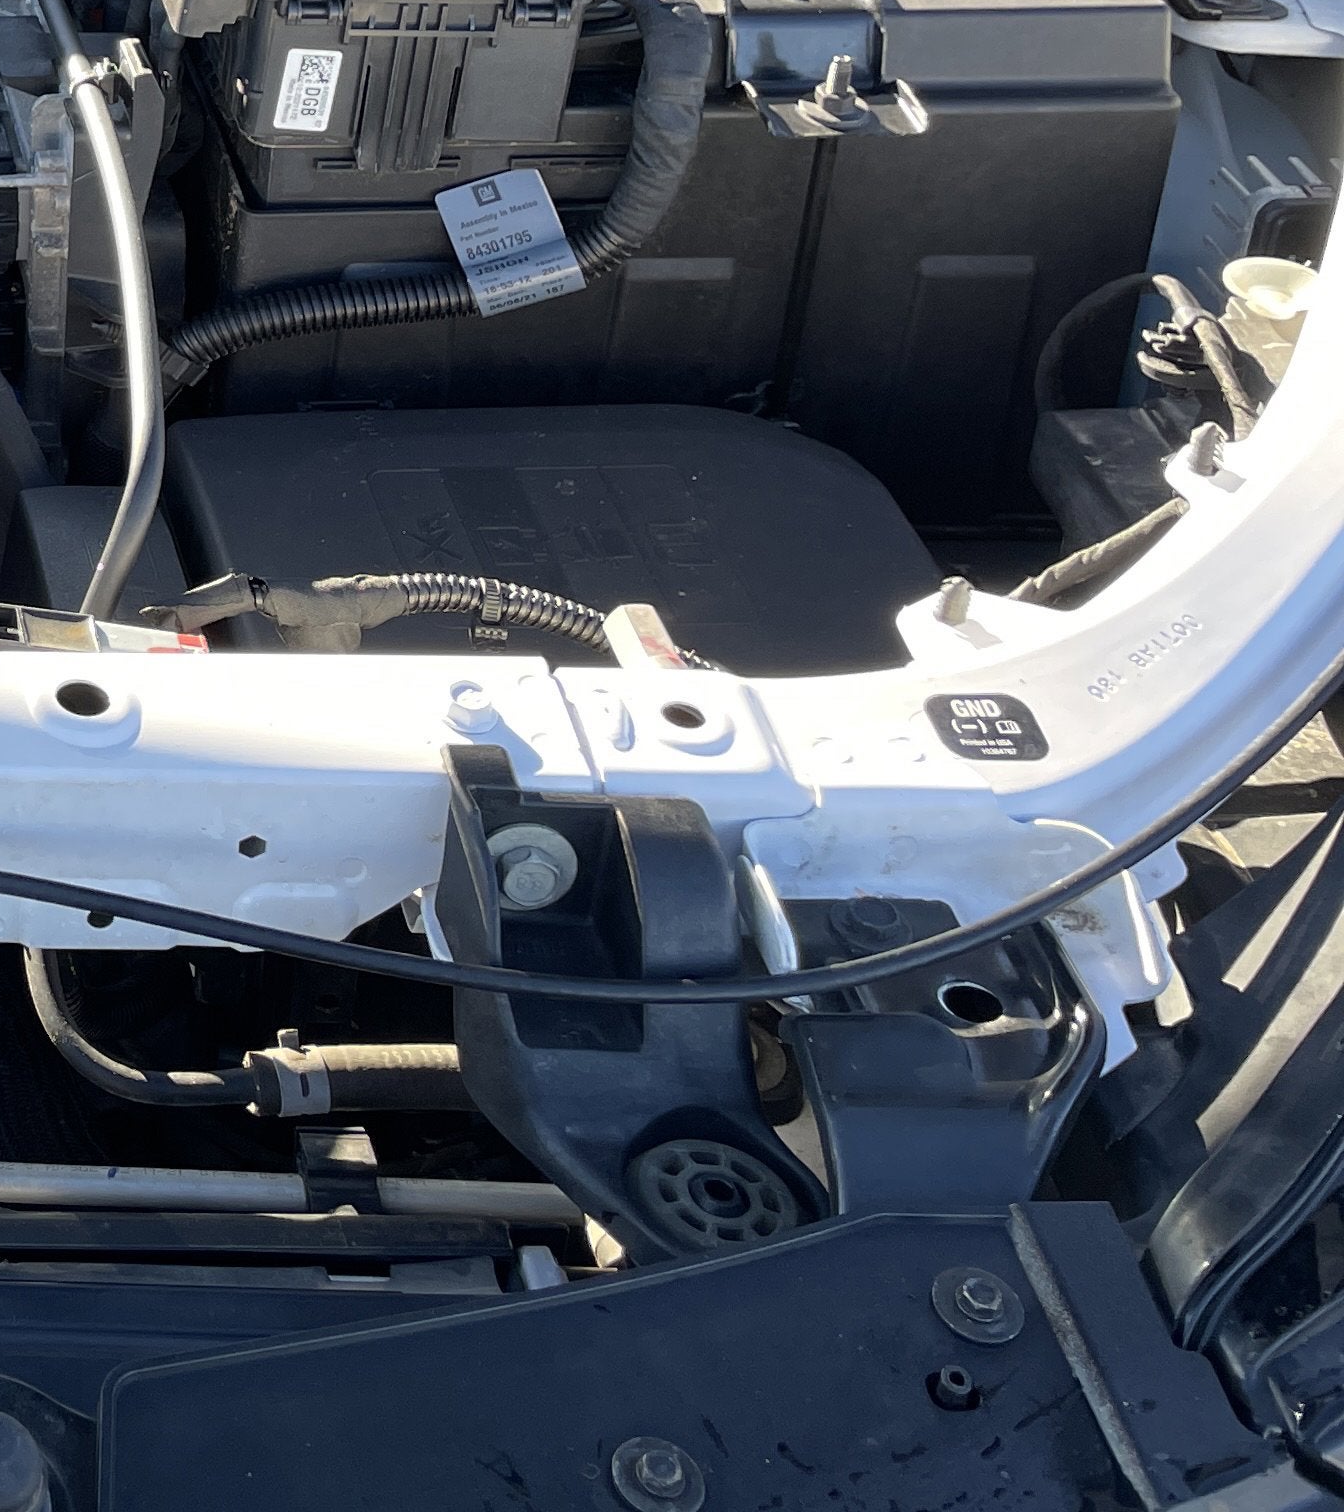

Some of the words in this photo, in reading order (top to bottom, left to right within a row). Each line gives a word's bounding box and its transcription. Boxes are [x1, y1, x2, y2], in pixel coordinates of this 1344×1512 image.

[460, 212, 498, 229] Assembly
[509, 200, 538, 213] Mexico
[465, 229, 533, 261] 84301795
[950, 699, 1002, 717] GND
